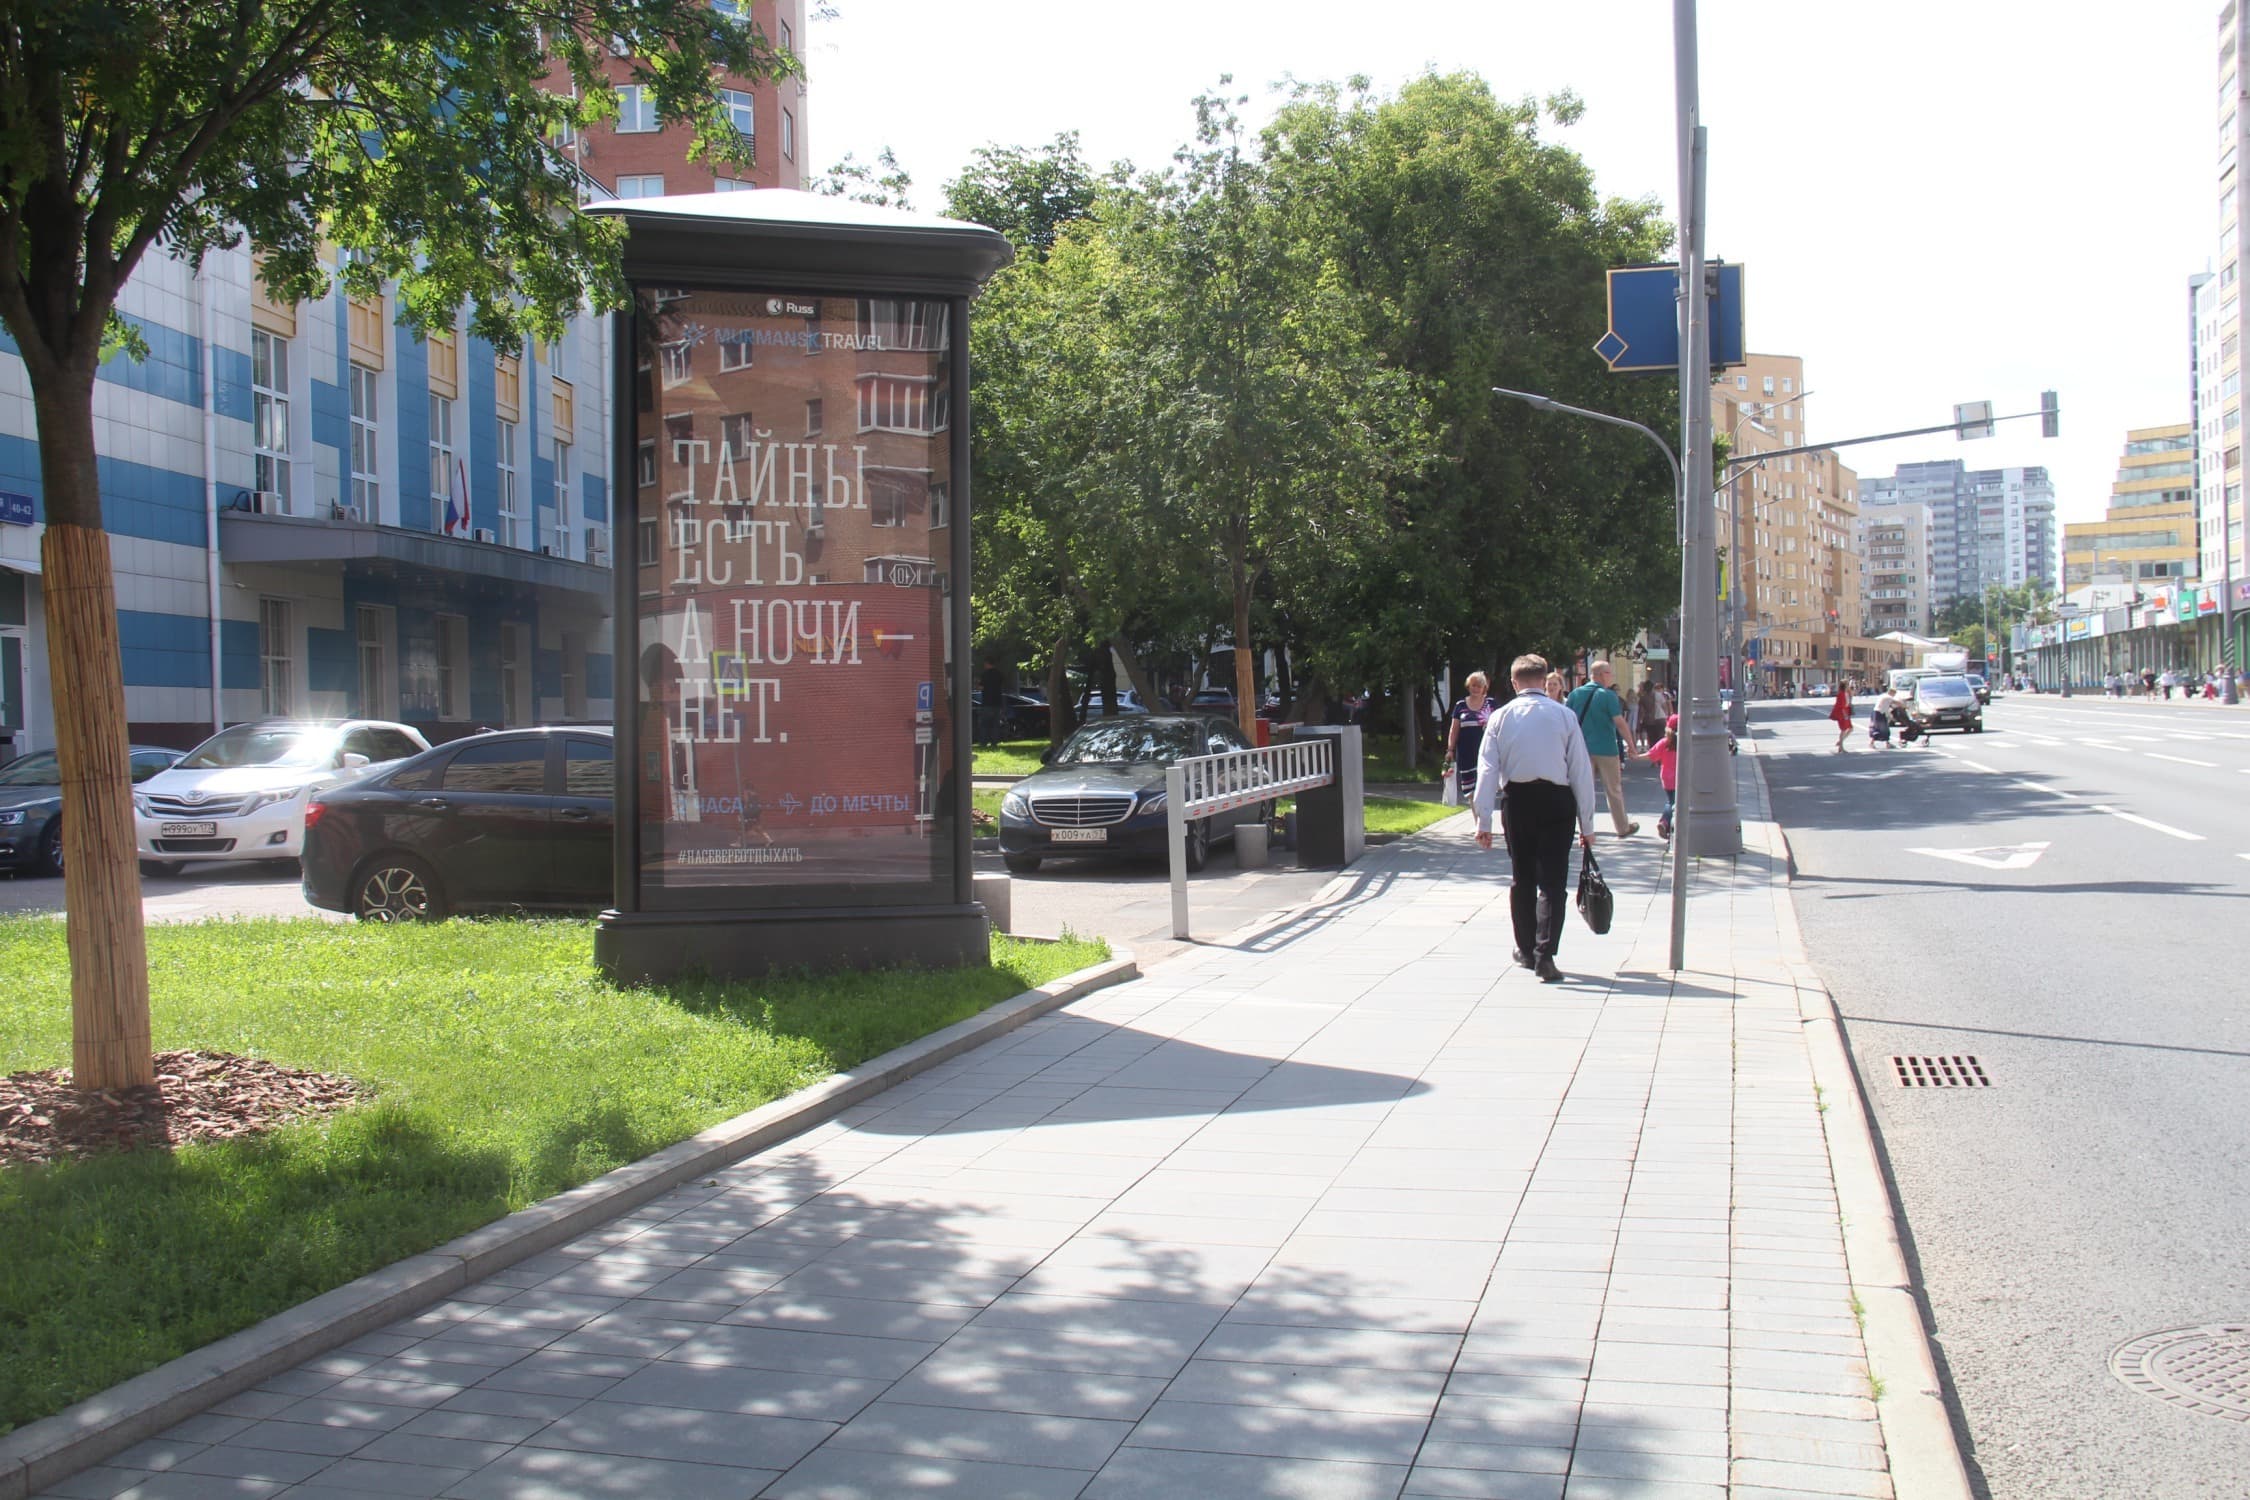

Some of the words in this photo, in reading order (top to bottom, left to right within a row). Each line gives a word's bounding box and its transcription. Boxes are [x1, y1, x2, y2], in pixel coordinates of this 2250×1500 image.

[786, 302, 815, 315] Russ
[672, 428, 868, 510] ТАЙНЫ
[674, 518, 817, 586] ЕСТЬ.
[674, 598, 710, 664] А
[729, 598, 862, 664] НОЧИ
[675, 677, 788, 743] НЕТ.
[694, 796, 744, 814] ЧАСА
[810, 796, 838, 816] ДО
[842, 794, 910, 813] МЕЧТЫ
